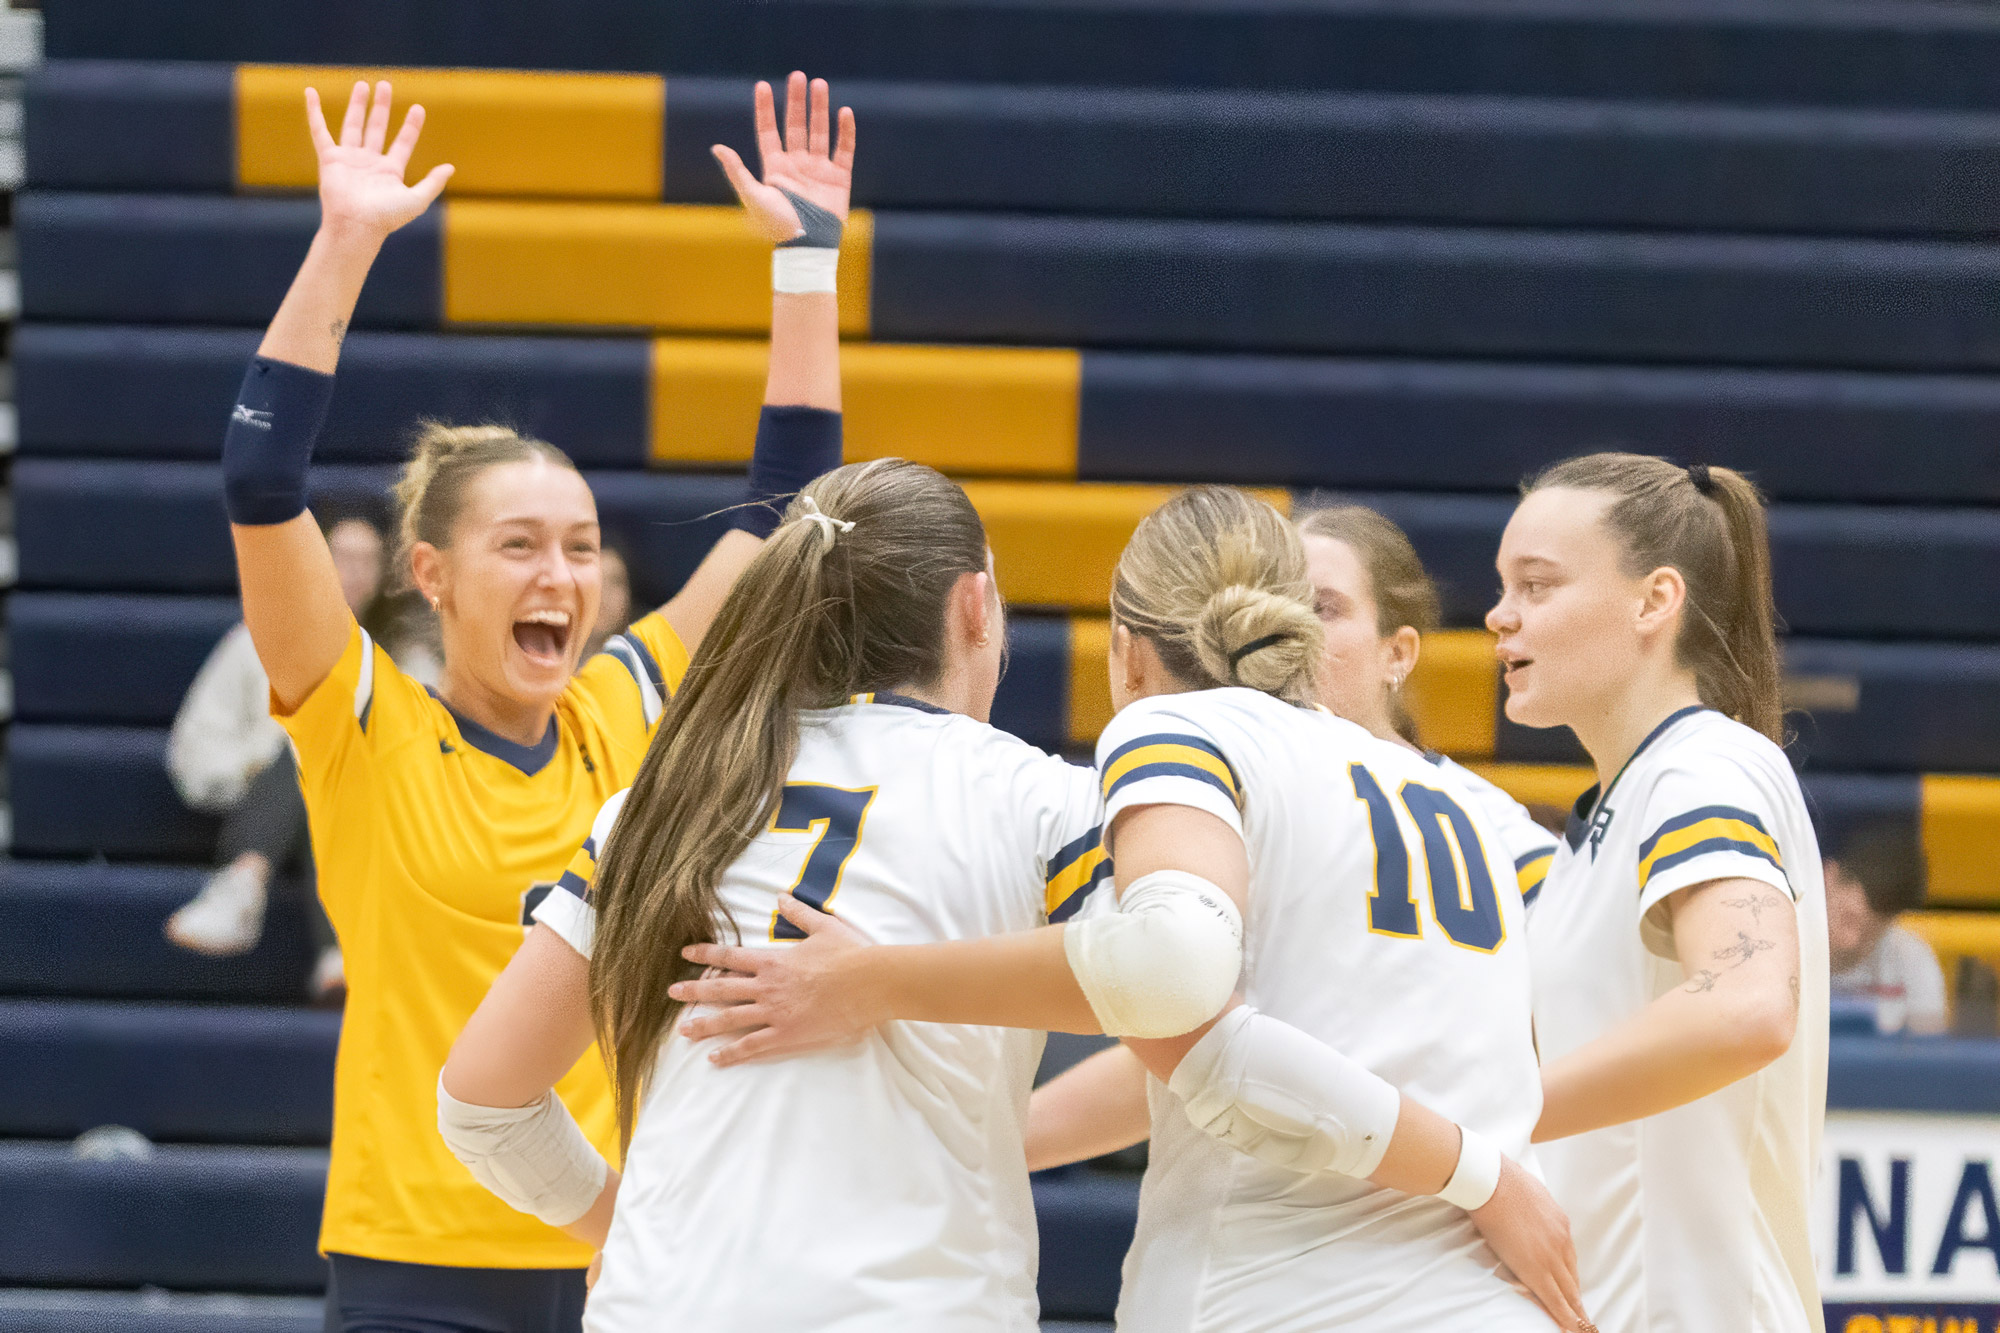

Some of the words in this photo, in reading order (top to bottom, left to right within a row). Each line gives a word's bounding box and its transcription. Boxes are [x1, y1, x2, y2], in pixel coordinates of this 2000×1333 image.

[768, 781, 879, 942] 7
[1347, 761, 1507, 955] 10
[1836, 1157, 2000, 1275] NA
